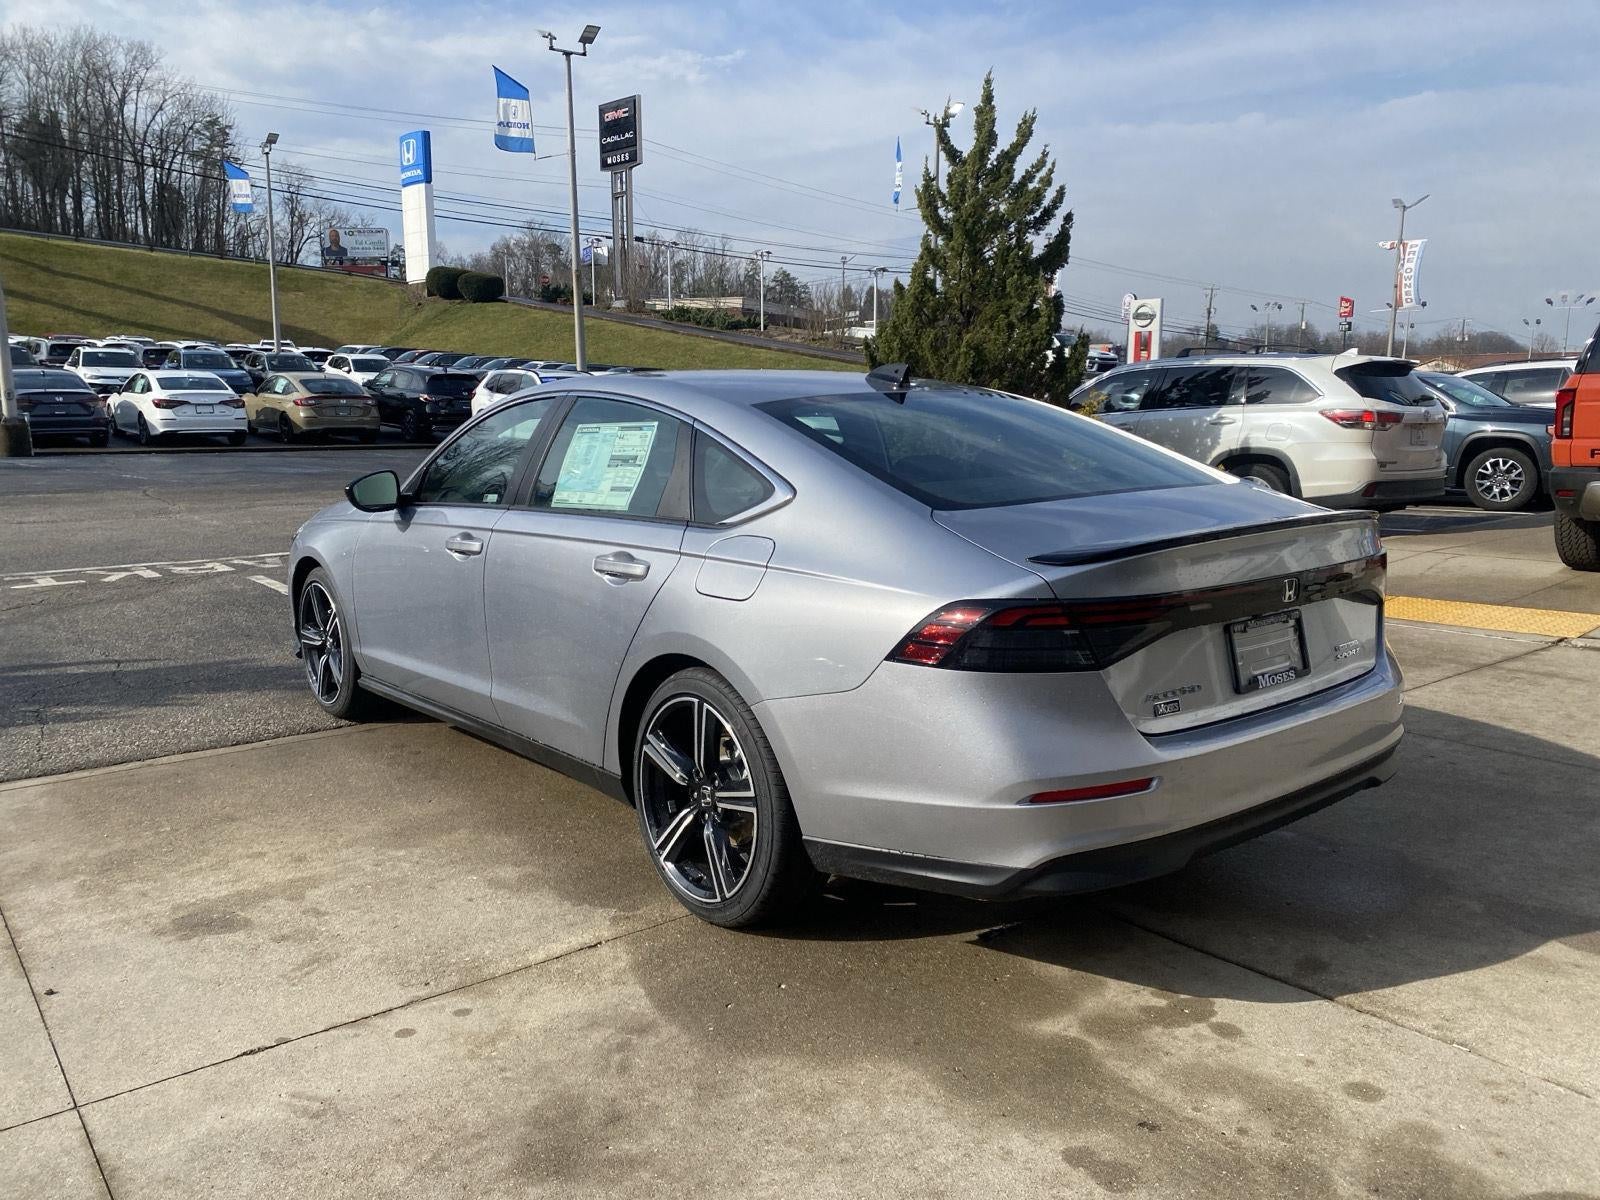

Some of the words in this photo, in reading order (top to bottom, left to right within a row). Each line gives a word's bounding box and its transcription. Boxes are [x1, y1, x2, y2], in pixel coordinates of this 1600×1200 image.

[604, 107, 629, 122] GMC
[601, 131, 634, 145] CADILLAC
[607, 152, 630, 165] MOSES
[1406, 243, 1419, 264] PRE
[1404, 267, 1413, 304] OWNED
